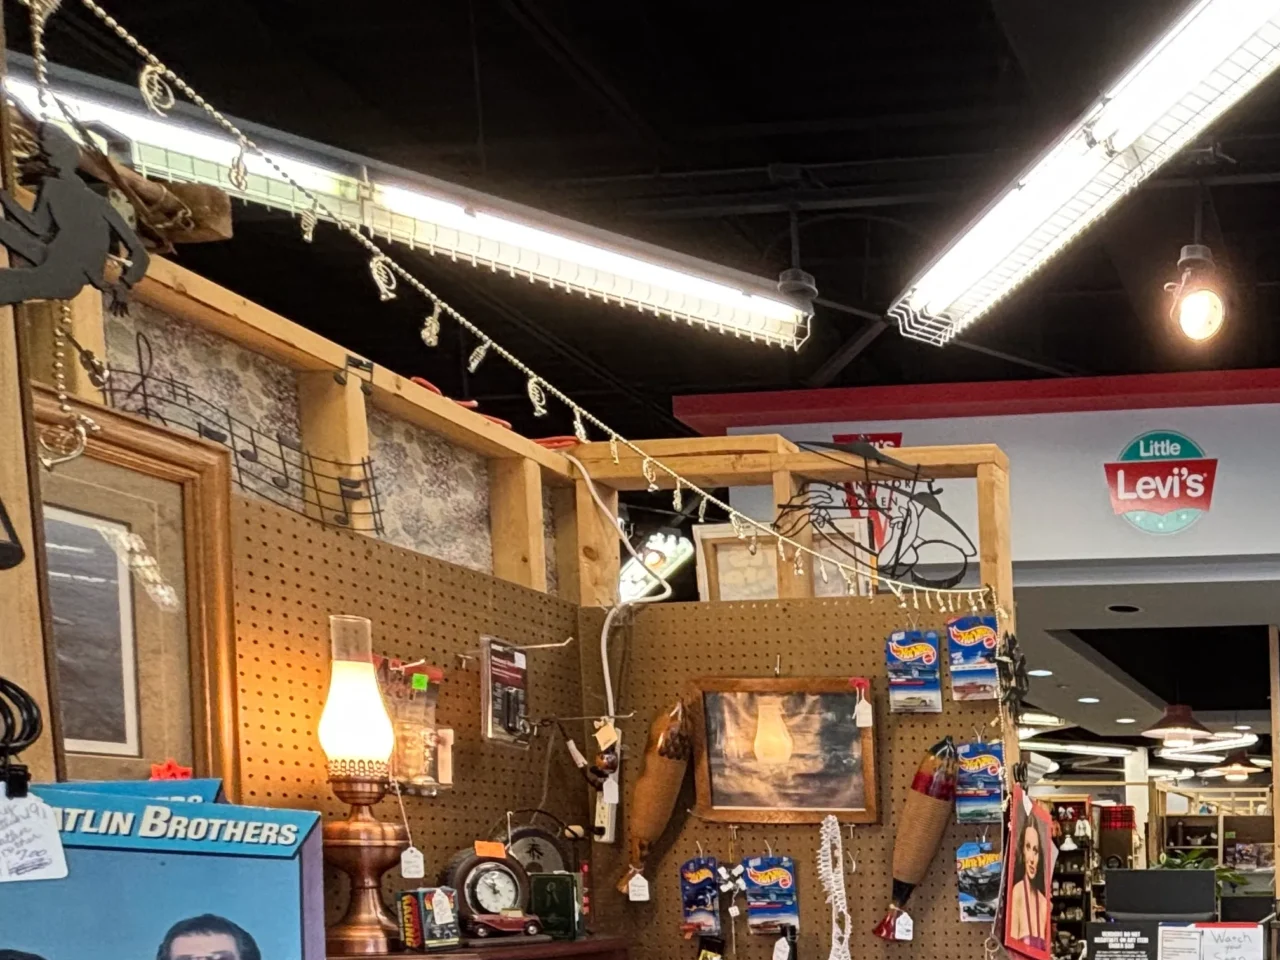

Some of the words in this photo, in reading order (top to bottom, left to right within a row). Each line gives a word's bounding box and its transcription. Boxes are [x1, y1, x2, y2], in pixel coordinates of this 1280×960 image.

[1139, 439, 1181, 457] Little
[1117, 467, 1205, 500] Levi's
[54, 806, 136, 836] TLIN
[138, 804, 300, 846] BROTHERS
[1209, 929, 1252, 944] Watch
